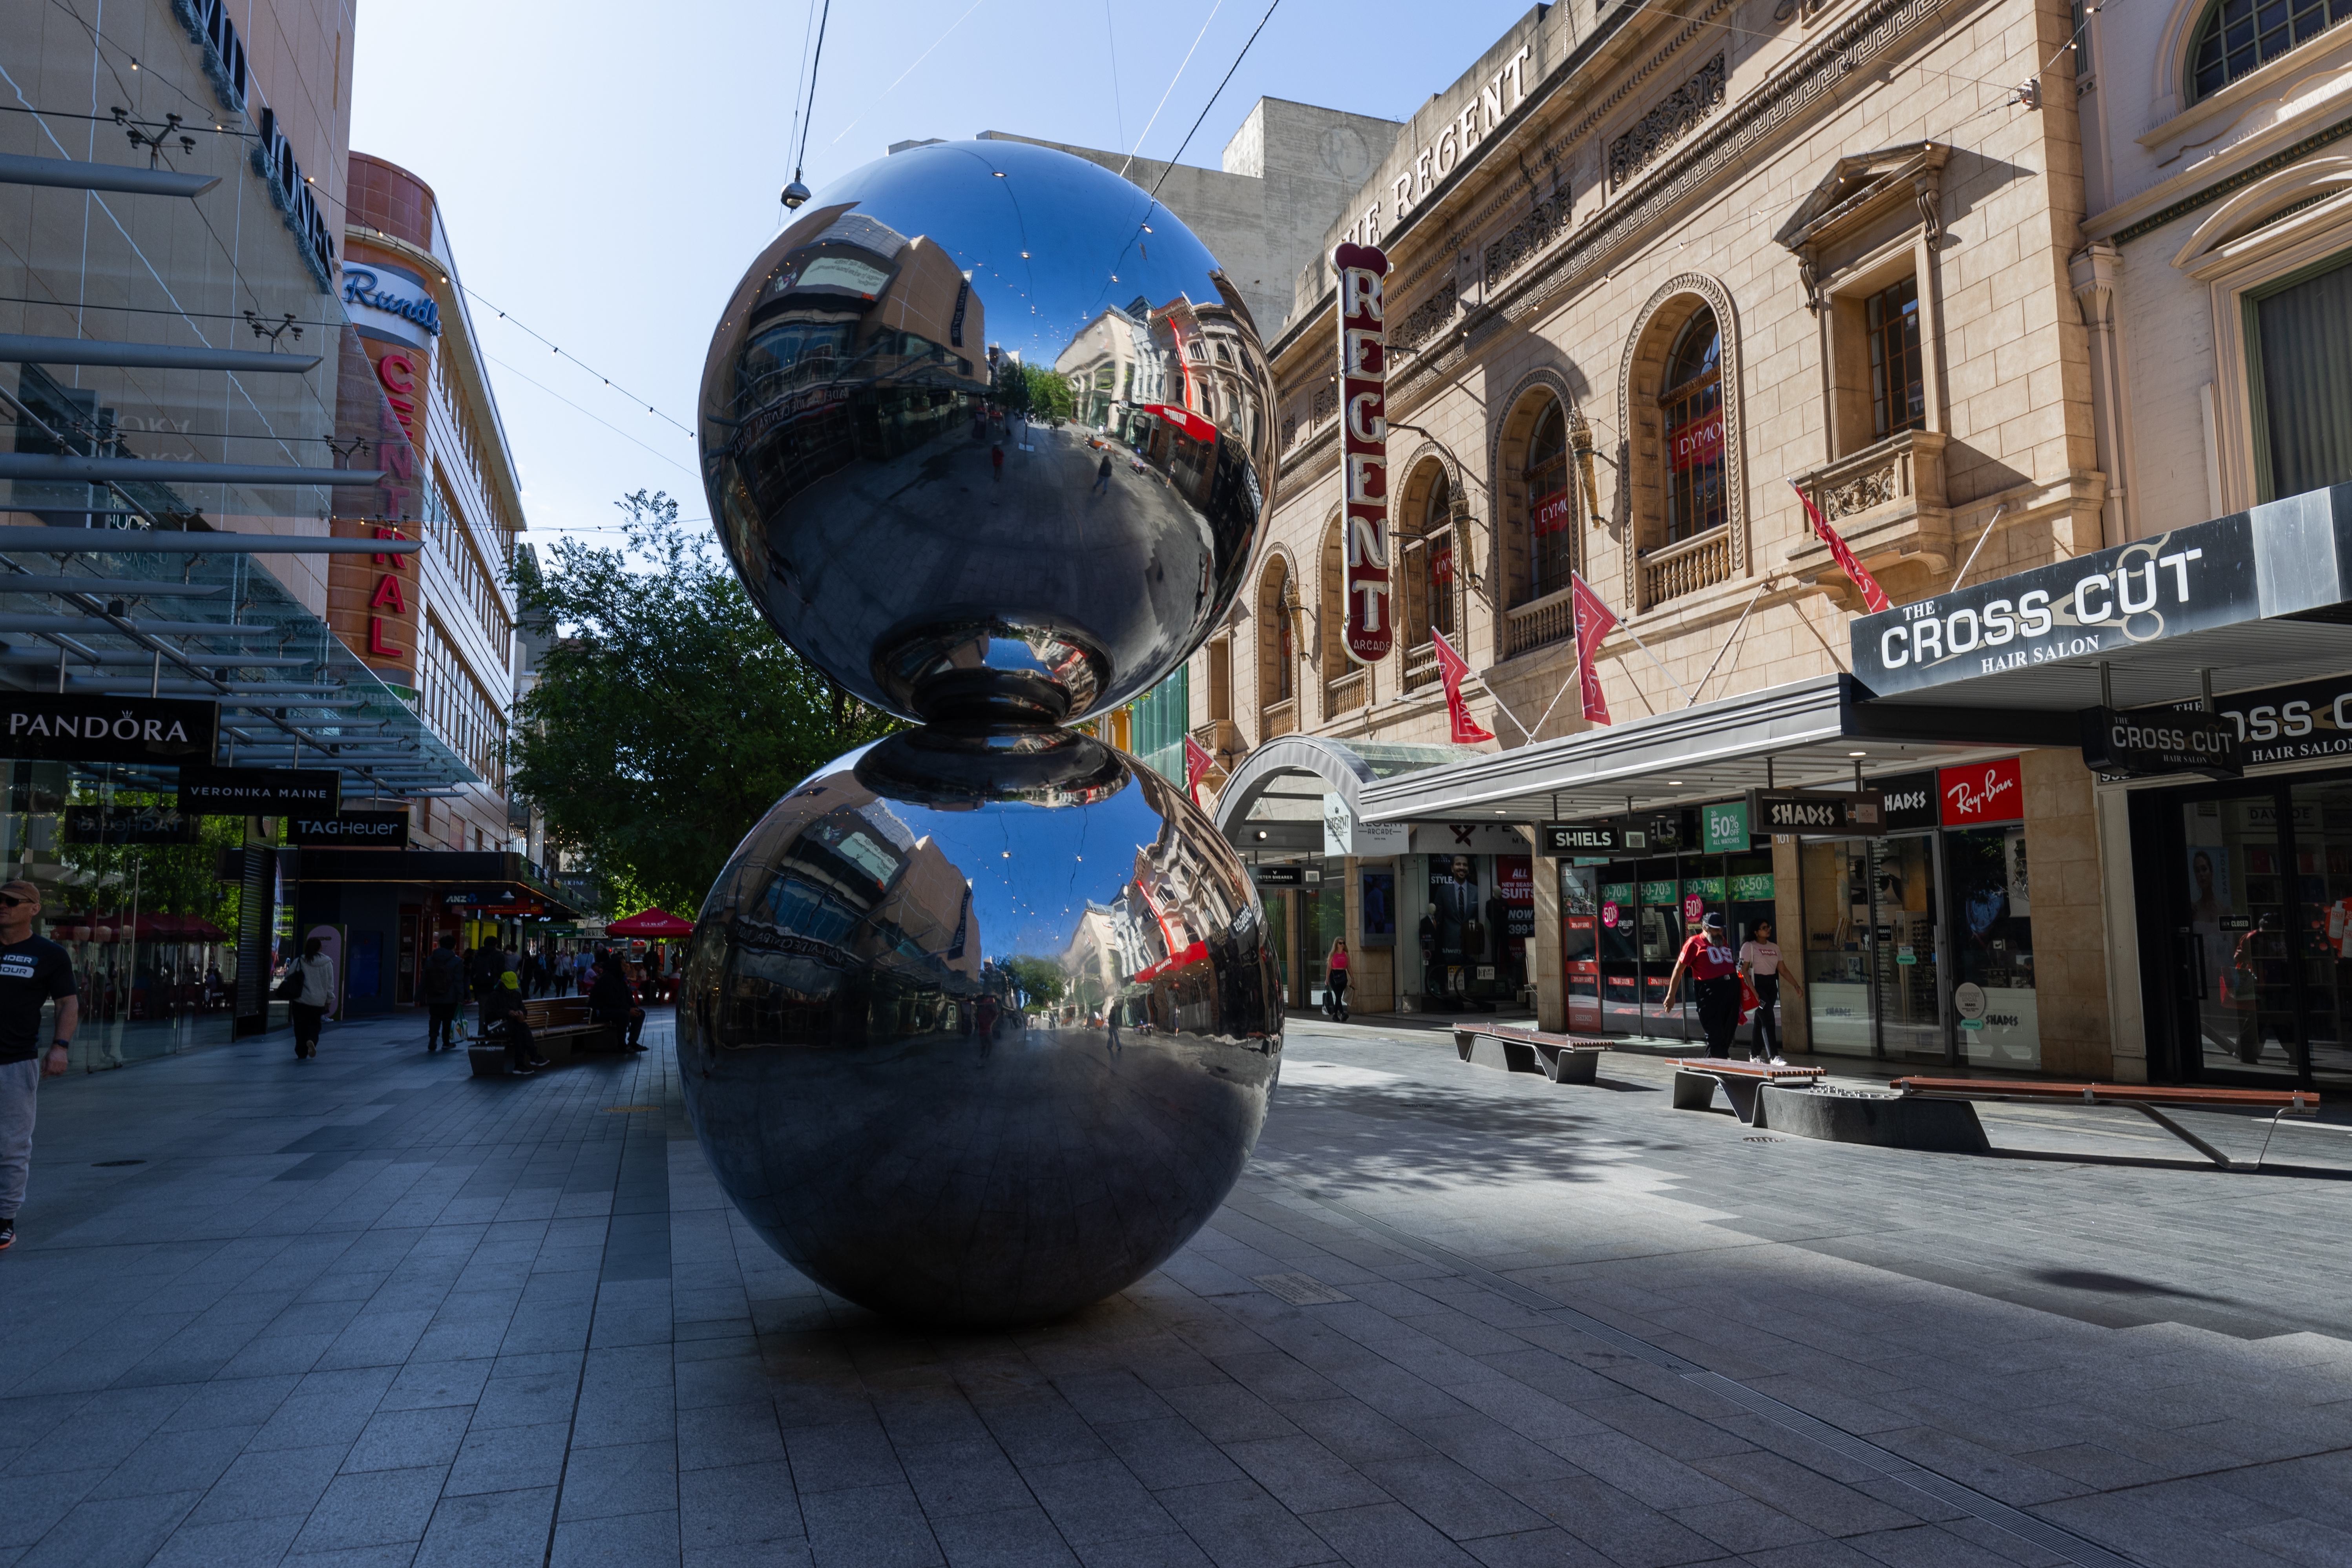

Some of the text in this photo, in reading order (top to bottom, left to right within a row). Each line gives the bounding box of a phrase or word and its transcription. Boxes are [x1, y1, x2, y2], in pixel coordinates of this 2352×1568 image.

[1391, 44, 1530, 229] REGENT
[1680, 422, 1724, 455] DYMO
[1344, 266, 1390, 632] REGENT
[1881, 548, 2202, 669] CROSS CUT
[1903, 601, 1935, 621] THE
[1353, 639, 1390, 653] ARCADE
[1981, 634, 2100, 674] HAIR SALON
[9, 711, 188, 743] PANDORA
[2114, 716, 2129, 725] THE
[2112, 726, 2232, 753] CROSS CUT
[2163, 754, 2207, 764] HAIR SALON
[2251, 746, 2295, 762] HAIR
[190, 787, 327, 798] VERONIKA MAINE
[1771, 804, 1835, 826] SHADES
[2250, 809, 2310, 820] DAVOE
[1555, 832, 1612, 847] SHIELS
[1776, 834, 1790, 844] 101
[1512, 868, 1528, 877] ALL
[1508, 909, 1534, 919] NOW
[1985, 1014, 2018, 1026] SHADES
